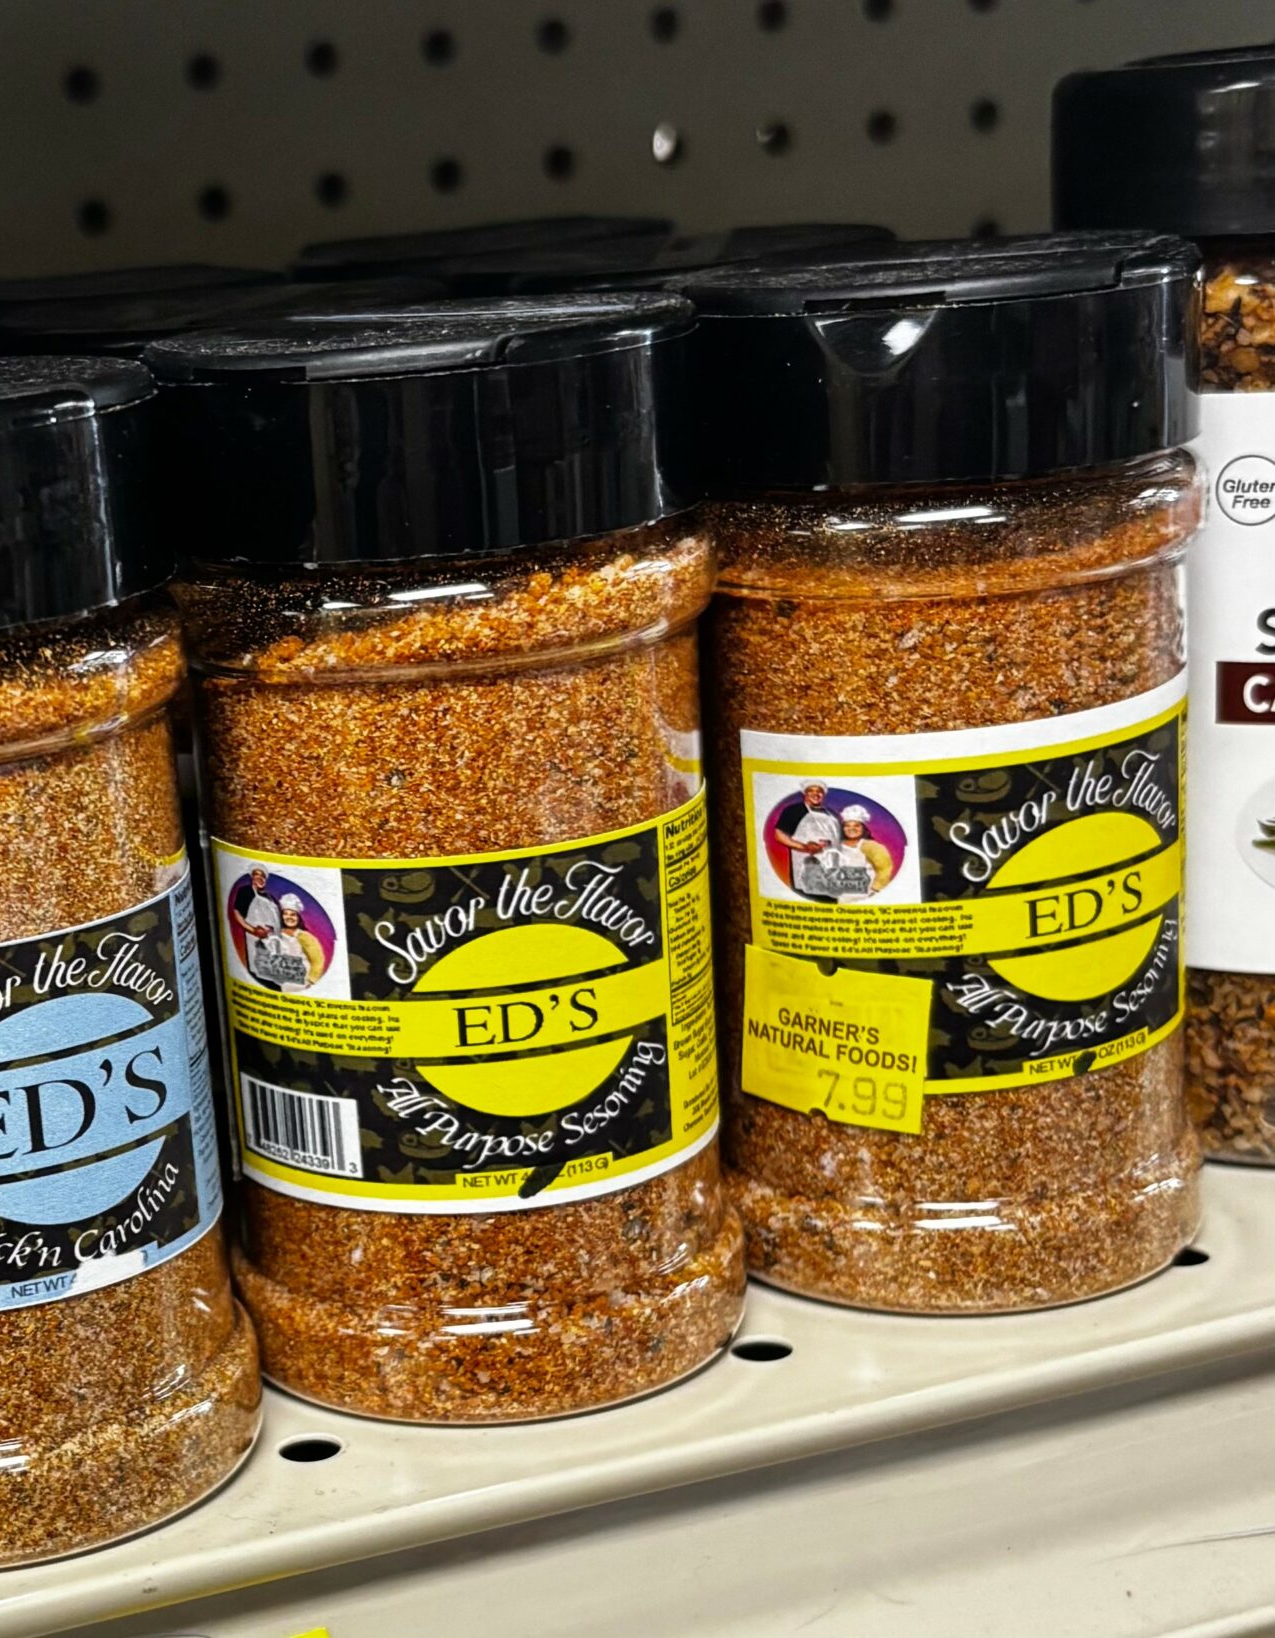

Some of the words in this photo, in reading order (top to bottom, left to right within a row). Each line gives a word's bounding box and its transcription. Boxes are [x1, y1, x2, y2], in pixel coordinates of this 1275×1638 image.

[1232, 495, 1270, 508] Free
[949, 790, 1056, 882] Savor
[1066, 761, 1113, 812] the
[1113, 749, 1175, 829] Flavor
[374, 897, 485, 984] Savor
[496, 868, 554, 921] the
[554, 860, 655, 948] Flavor
[1025, 871, 1143, 939] ED'S
[32, 945, 87, 995] the
[87, 932, 174, 1006] Flavor
[946, 973, 1017, 1013] All
[986, 1002, 1107, 1056] Purpose
[1113, 919, 1178, 1023] Sesoning
[452, 988, 598, 1048] ED'S
[747, 1018, 830, 1060] NATURAL
[836, 1044, 918, 1074] FOODS!
[778, 1007, 880, 1045] GARNER'S
[1029, 1061, 1055, 1075] NET
[1098, 1044, 1115, 1058] OZ
[376, 1077, 447, 1119] All
[415, 1111, 554, 1170] Purpose
[560, 1040, 667, 1145] Sesoning
[817, 1069, 907, 1120] 7.99
[349, 1162, 358, 1174] 3
[463, 1175, 492, 1188] NET
[494, 1173, 518, 1186] WT
[567, 1161, 593, 1178] (113
[75, 1162, 180, 1261] Carolina
[11, 1281, 43, 1299] NET
[44, 1275, 69, 1293] WT
